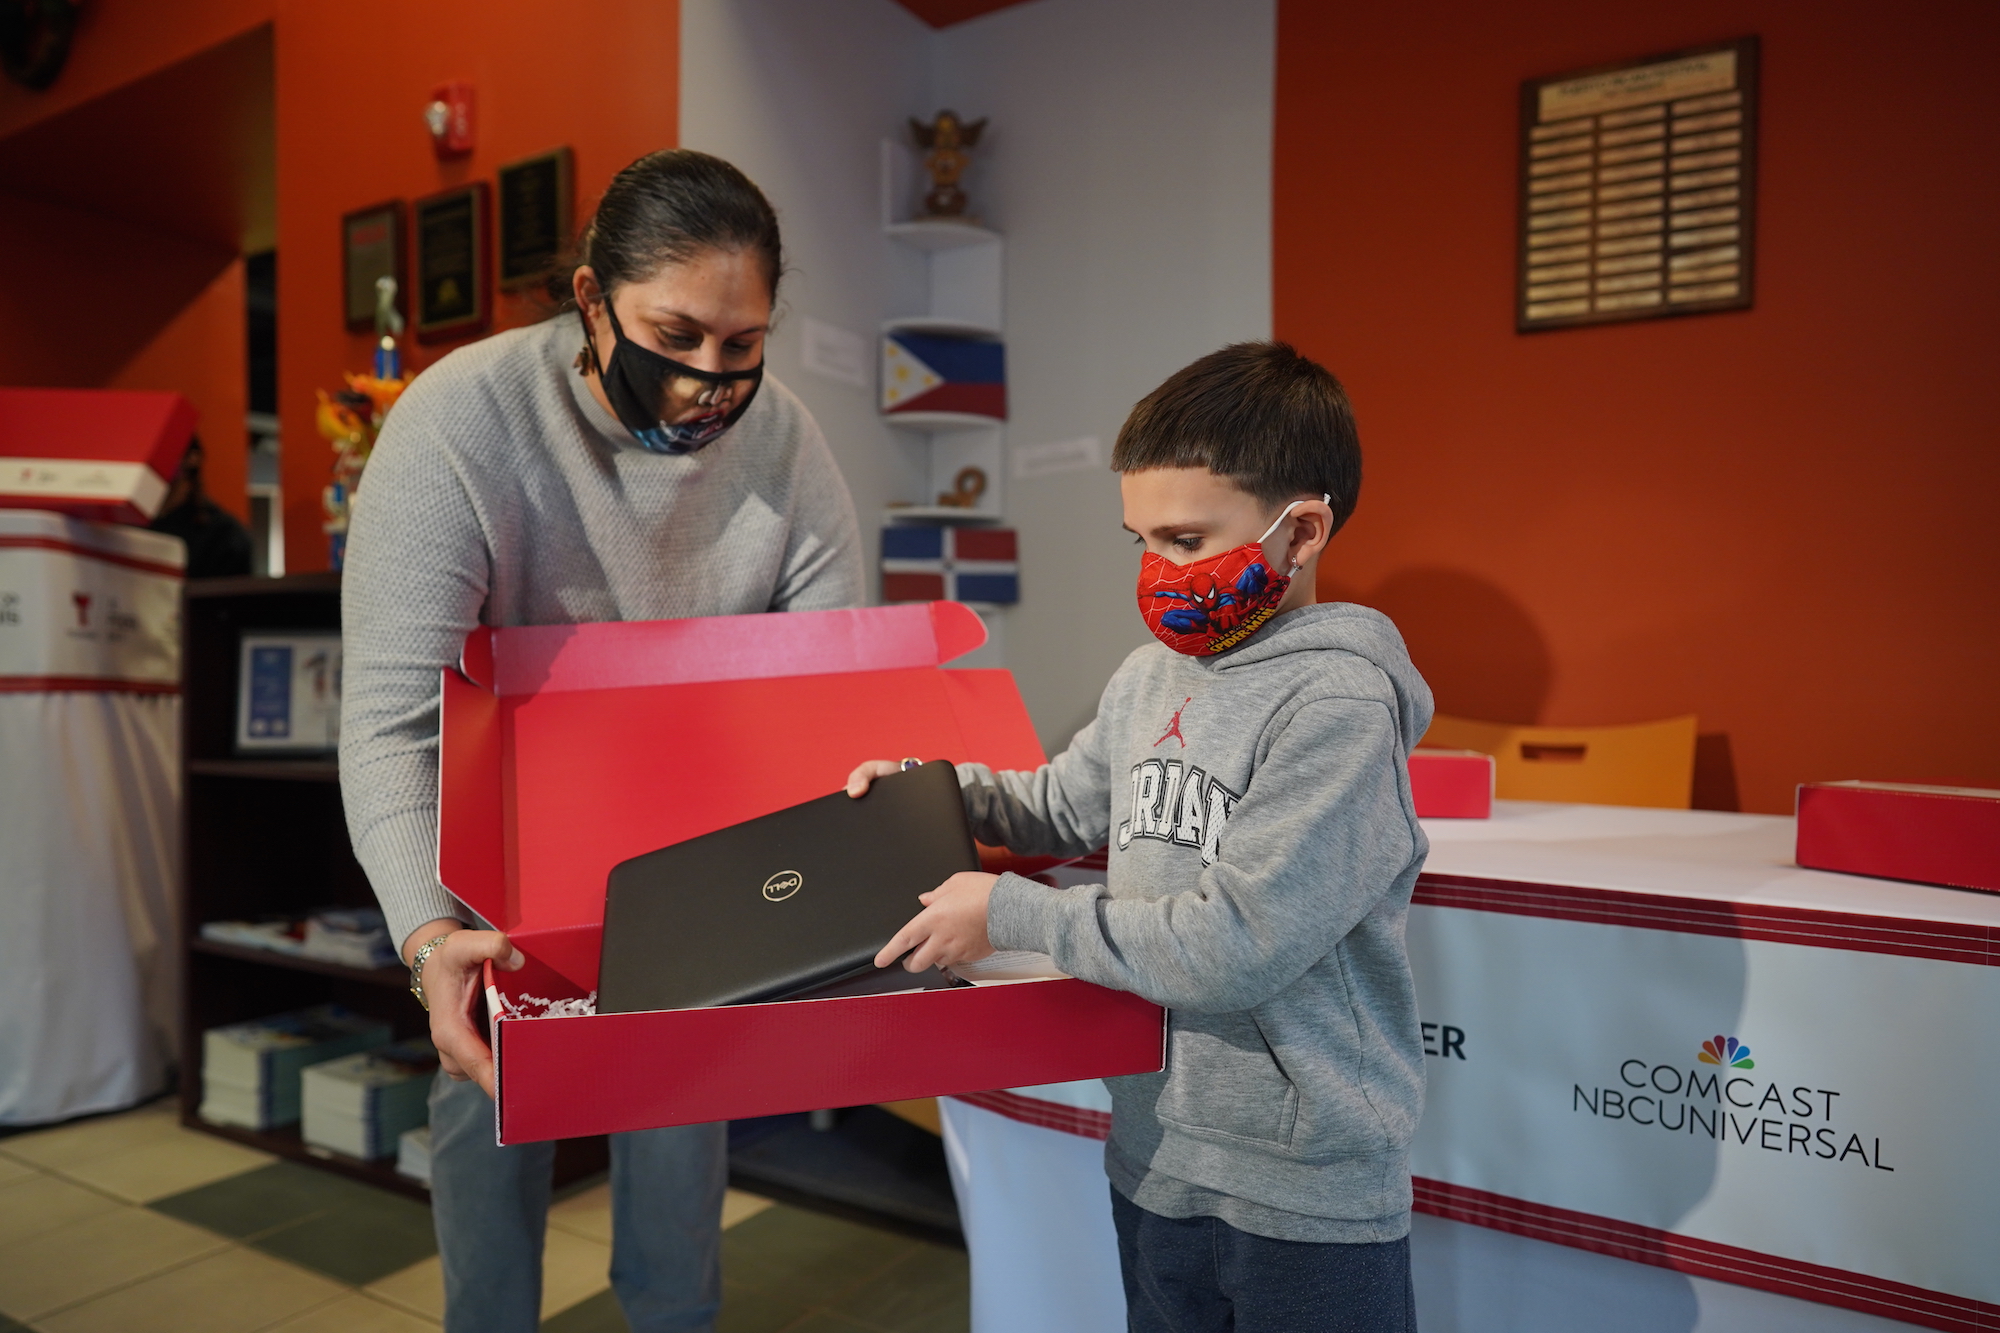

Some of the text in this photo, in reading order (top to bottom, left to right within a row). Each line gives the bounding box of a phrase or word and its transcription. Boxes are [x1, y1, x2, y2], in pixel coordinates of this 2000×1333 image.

[766, 877, 798, 894] DELL
[1620, 1058, 1841, 1122] COMCAST
[1573, 1083, 1895, 1172] NBCUNIVERSAL
